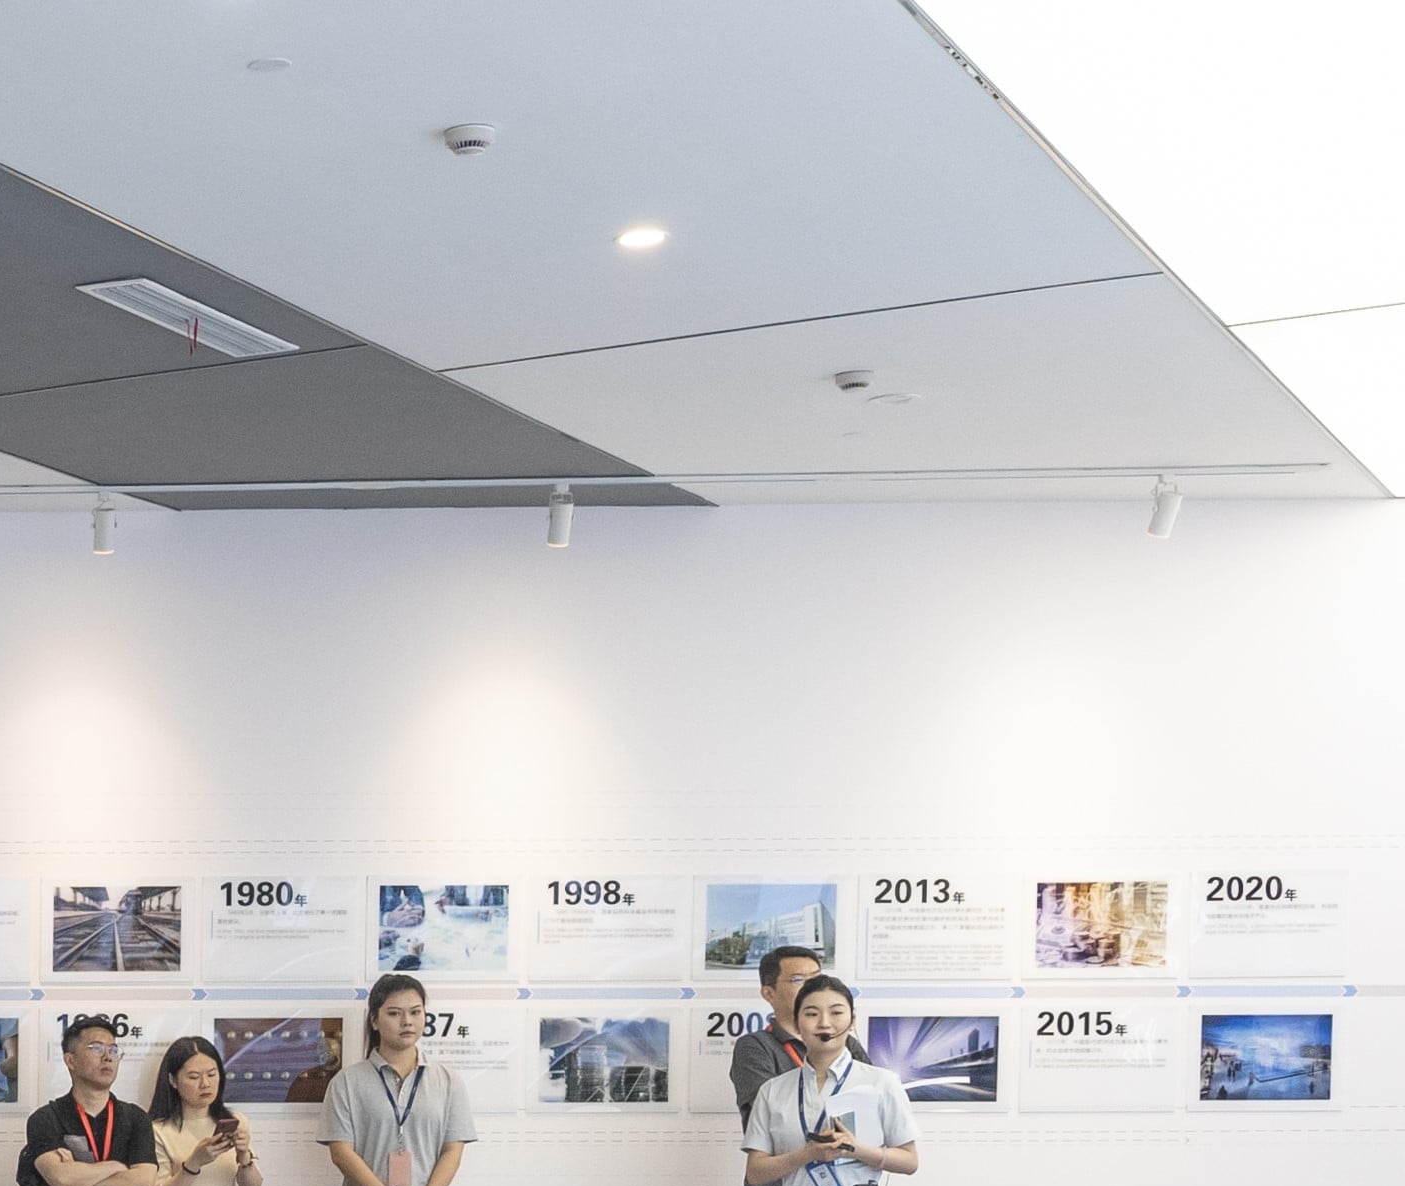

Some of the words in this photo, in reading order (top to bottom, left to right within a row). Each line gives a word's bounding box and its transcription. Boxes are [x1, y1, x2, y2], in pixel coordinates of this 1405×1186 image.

[220, 881, 307, 907] 1980年
[548, 880, 635, 906] 1998年
[874, 878, 965, 904] 2013年
[1206, 876, 1297, 902] 2020年
[1036, 1011, 1128, 1037] 2015年
